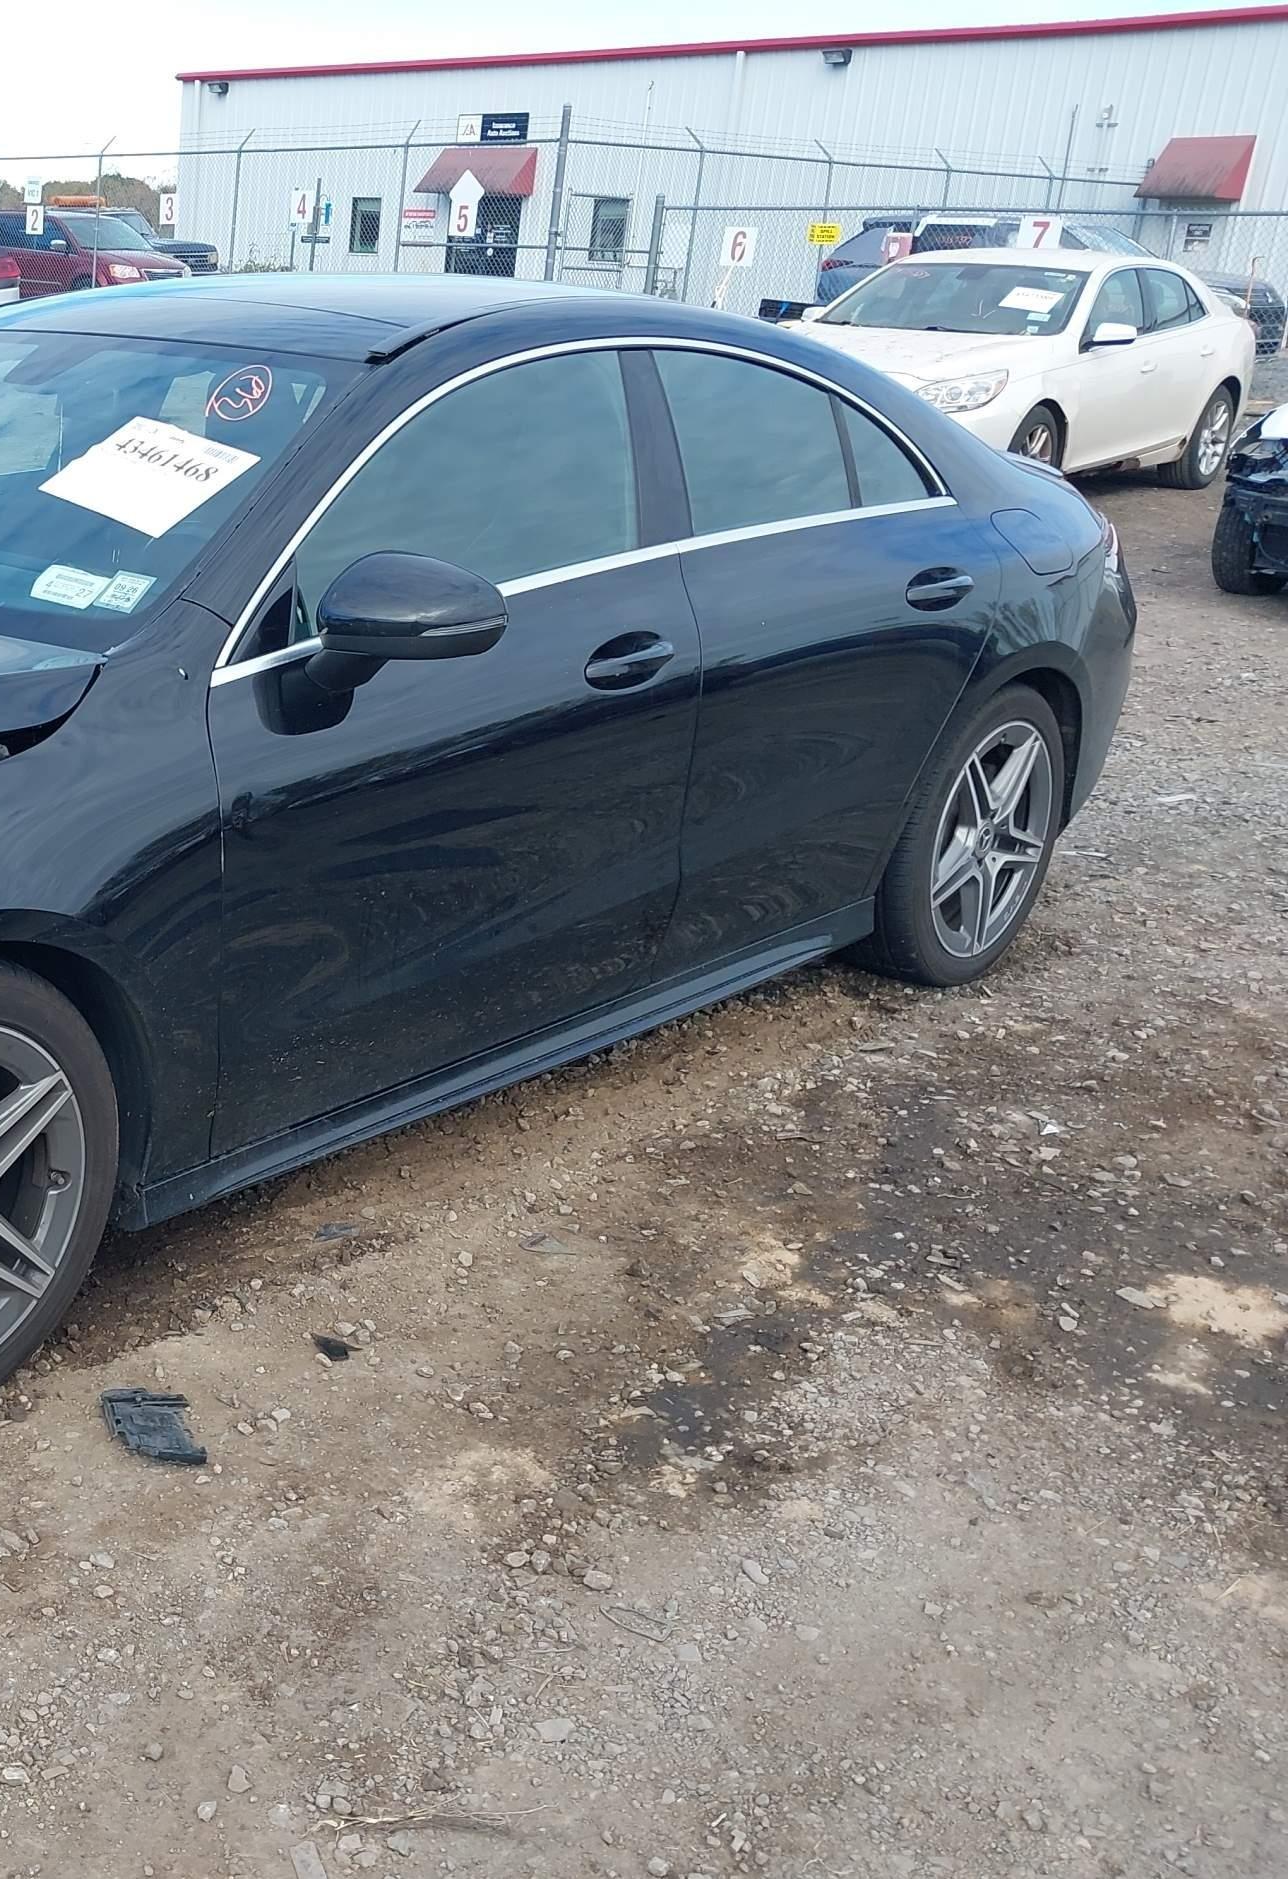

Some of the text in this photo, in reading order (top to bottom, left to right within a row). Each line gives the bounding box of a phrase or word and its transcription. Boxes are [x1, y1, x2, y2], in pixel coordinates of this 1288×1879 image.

[165, 197, 174, 221] 3
[297, 193, 306, 219] 4
[457, 205, 469, 232] 5
[31, 209, 39, 231] 2
[731, 231, 747, 262] 6
[1032, 221, 1050, 248] 7
[115, 438, 219, 482] 43461468
[75, 588, 94, 599] 27
[114, 583, 138, 594] 09 26
